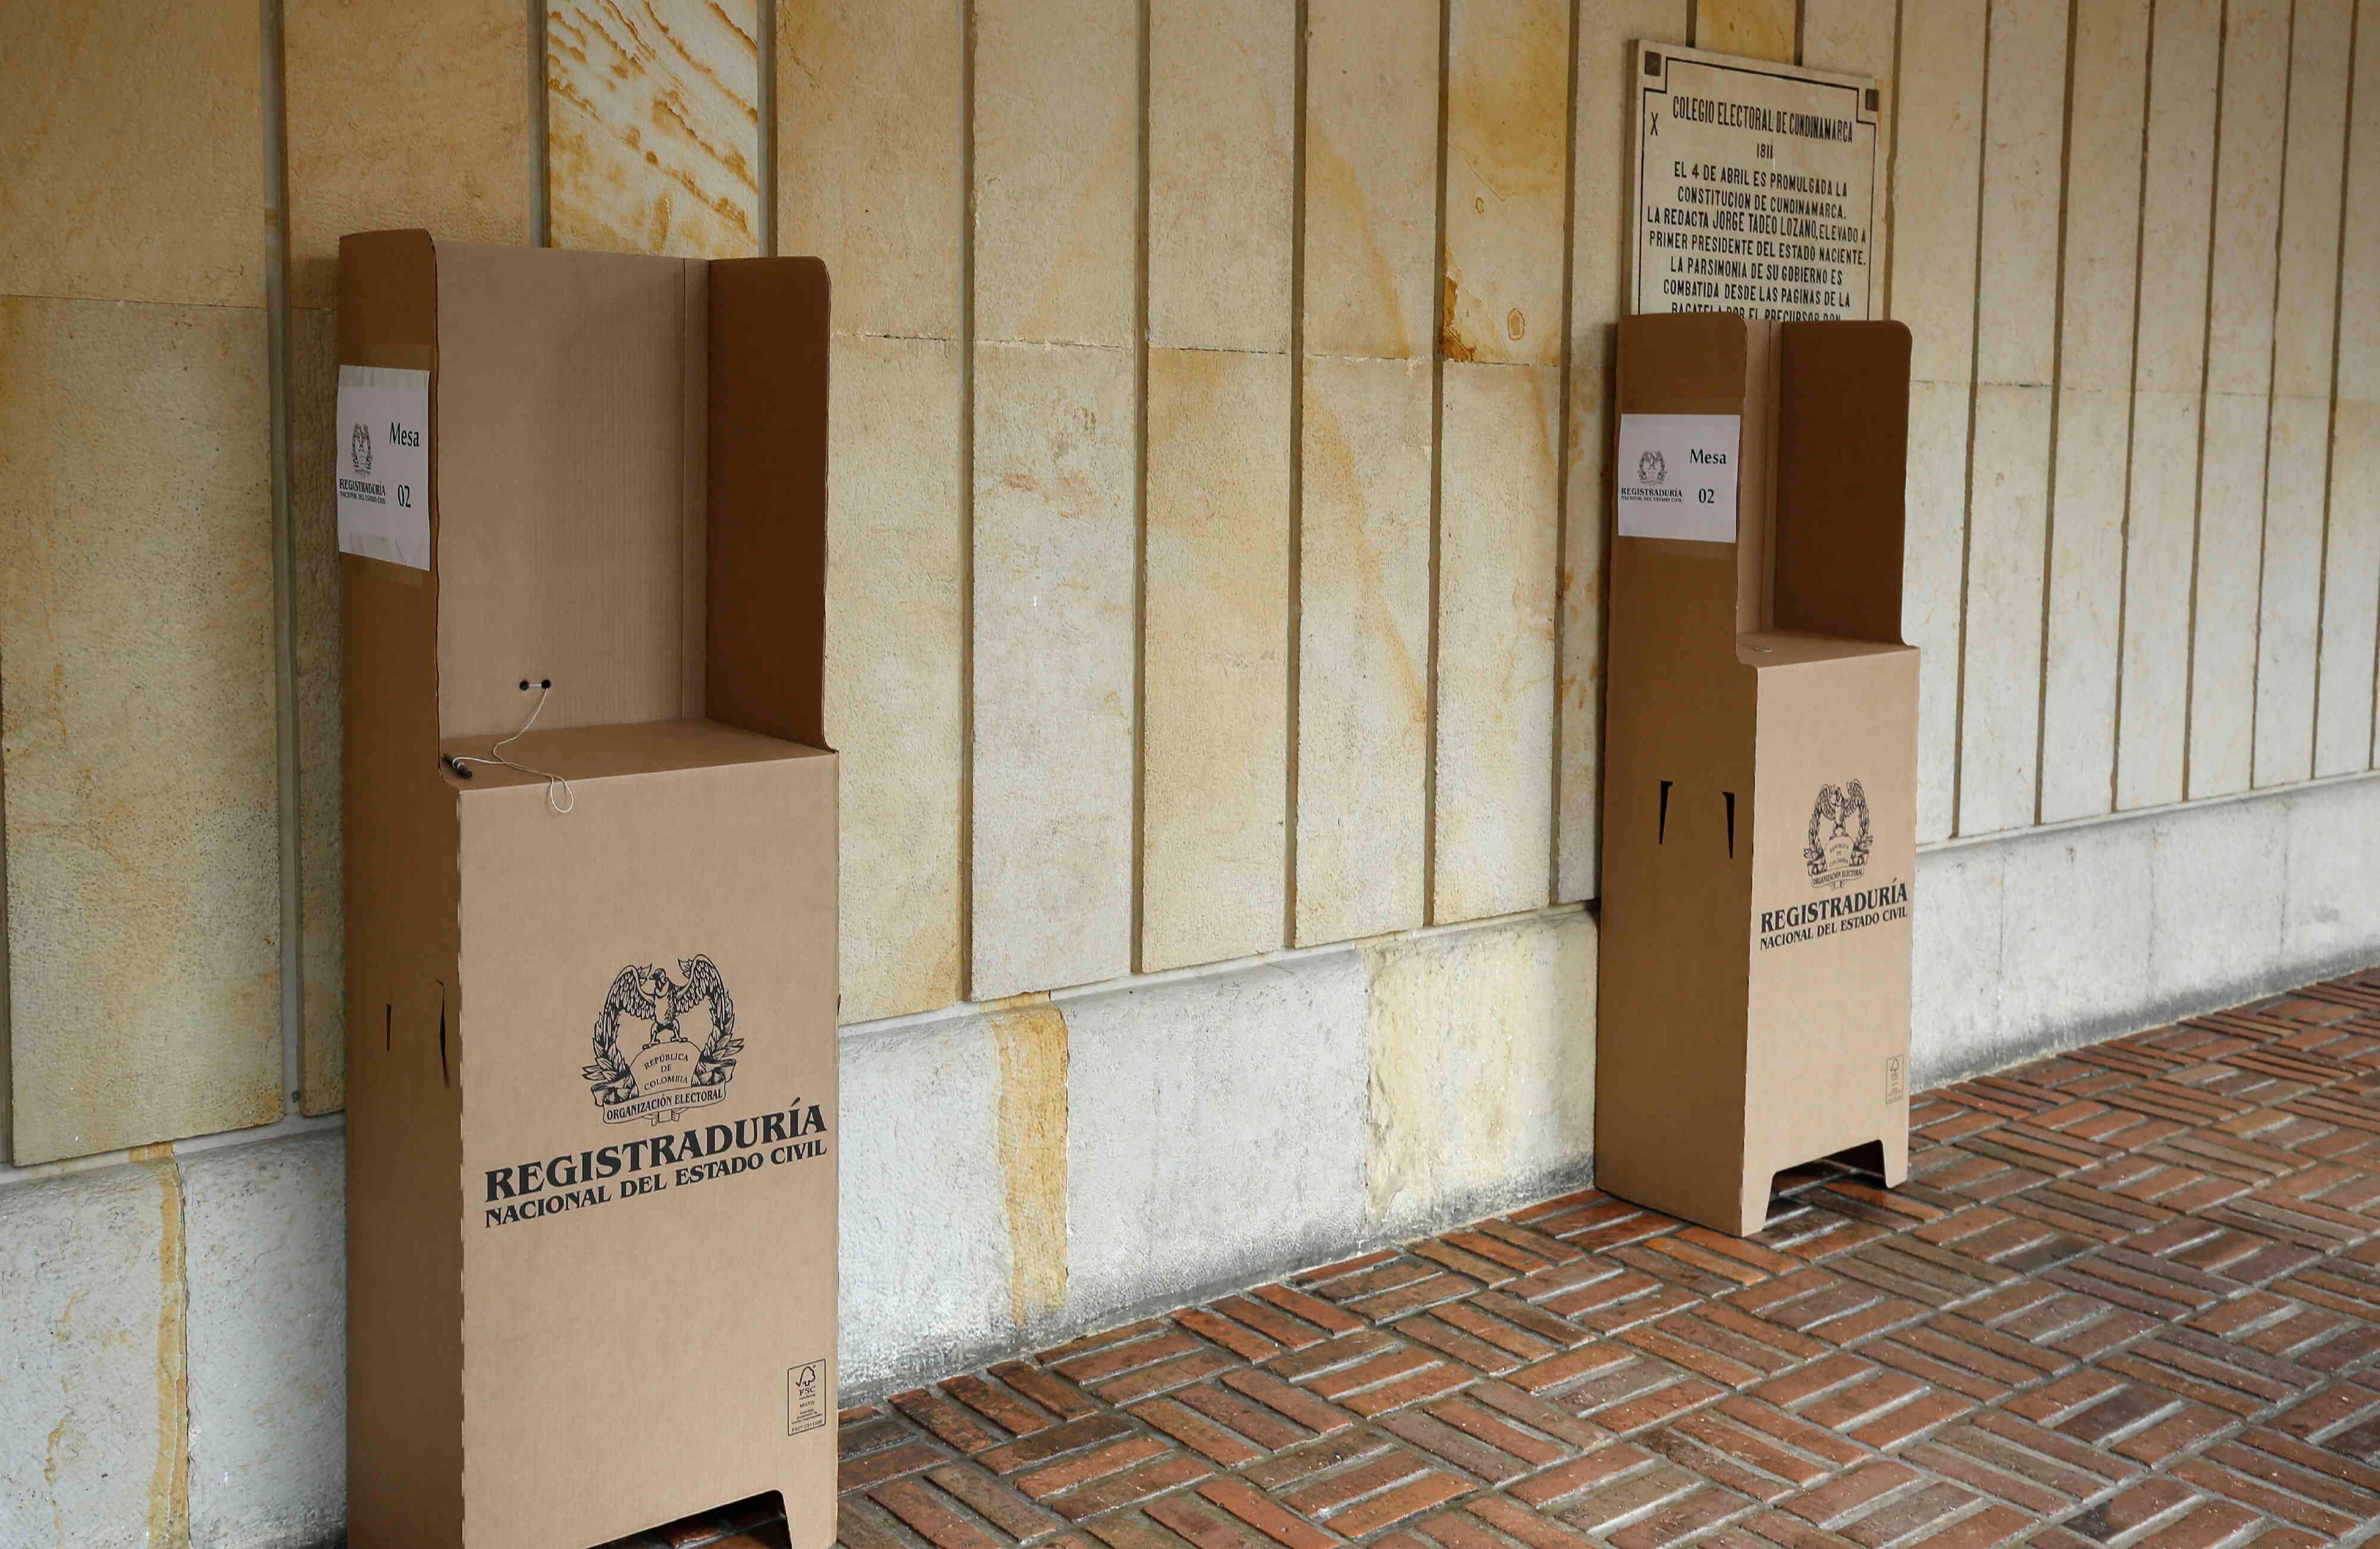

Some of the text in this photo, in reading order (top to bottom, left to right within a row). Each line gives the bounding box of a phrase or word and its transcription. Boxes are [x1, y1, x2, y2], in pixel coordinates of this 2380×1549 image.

[1651, 112, 1659, 136] X
[1673, 95, 1853, 143] COLEGIO ELECTORAL DE CUNDINAMARCA
[1756, 143, 1773, 159] 1811
[1674, 161, 1847, 197] EL 4 DE ABRIL ES PROMULGADA LA
[1677, 186, 1847, 220] CONSTITUCION DE CUNDINAMARCA.
[1647, 206, 1867, 244] LA REDACTA JORGE TADEO LOZANO, ELEVADO A
[1649, 230, 1867, 266] PRIMER PRESIDENTE DEL ESTADO NACIENTE.
[1671, 255, 1843, 286] LA PARSIMONIA DE SU GOBIERNO ES
[1663, 278, 1850, 308] COMBATIDA DESDE LAS PAGINAS DE LA
[389, 421, 419, 447] Mesa
[1690, 449, 1727, 465] Mesa
[339, 478, 386, 497] REGISTRADURÍA
[397, 484, 412, 508] 02
[1621, 487, 1683, 498] REGISTRADURÍA
[1698, 488, 1715, 503] 02
[1761, 877, 1908, 934] REGISTRADURÍA
[1760, 906, 1908, 951] NACIONAL DEL ESTADO CIVIL
[644, 1052, 689, 1070] REPÚBLICA
[660, 1064, 672, 1073] DE
[644, 1076, 688, 1091] COLOMBIA
[606, 1089, 724, 1121] ORGANIZACIÓN ELECTORAL
[484, 1097, 828, 1203] REGISTRADURÍA
[485, 1139, 828, 1229] NACIONAL DEL ESTADO CIVIL
[799, 1385, 815, 1396] FSC
